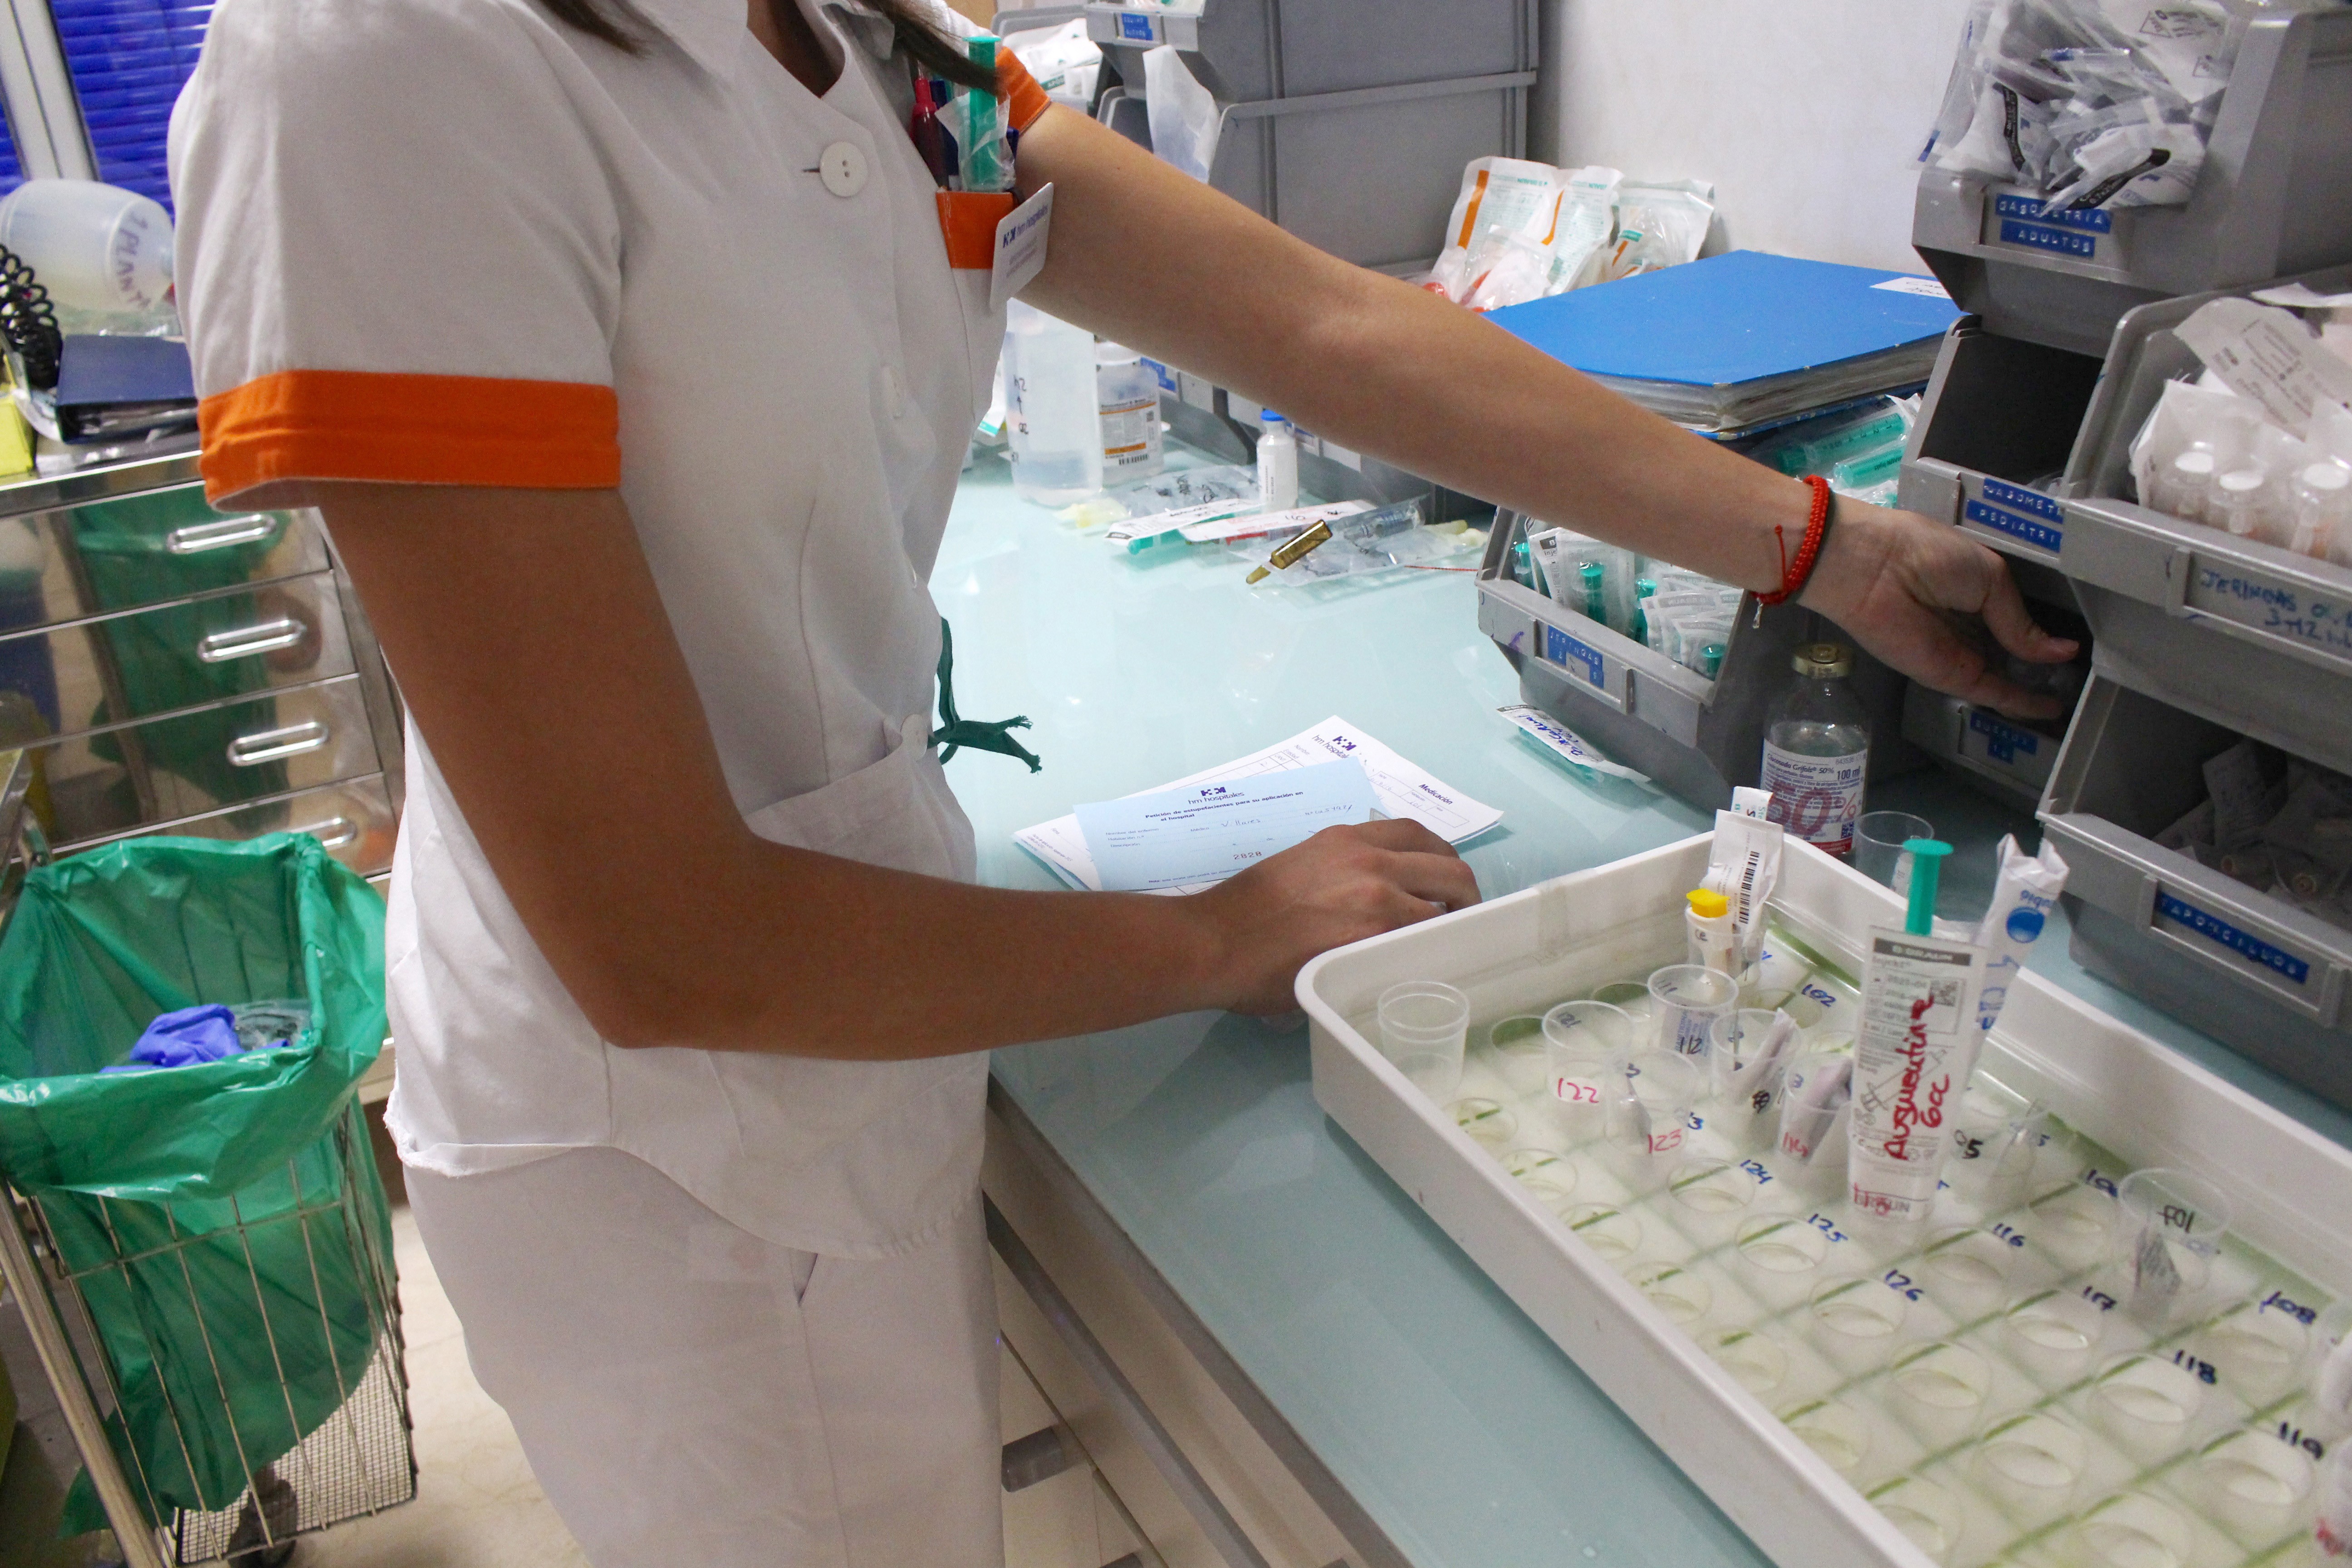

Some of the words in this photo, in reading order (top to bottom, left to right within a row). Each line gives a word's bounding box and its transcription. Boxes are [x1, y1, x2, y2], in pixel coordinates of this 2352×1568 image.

[1183, 803, 1234, 813] estupefacientes
[1261, 793, 1294, 801] aplicación
[1204, 791, 1245, 803] hospitales
[1418, 784, 1453, 805] Medicación
[1168, 813, 1195, 822] hospital
[1233, 851, 1262, 860] 2828
[1802, 983, 1837, 1008] 102
[1557, 1077, 1600, 1103] 122
[1647, 1128, 1682, 1154] 123
[1740, 1159, 1773, 1185] 124
[1808, 1213, 1848, 1243] 125
[1993, 1223, 2025, 1247] 116
[1885, 1269, 1924, 1302] 126
[2173, 1349, 2217, 1385] 118
[2278, 1421, 2324, 1460] 119
